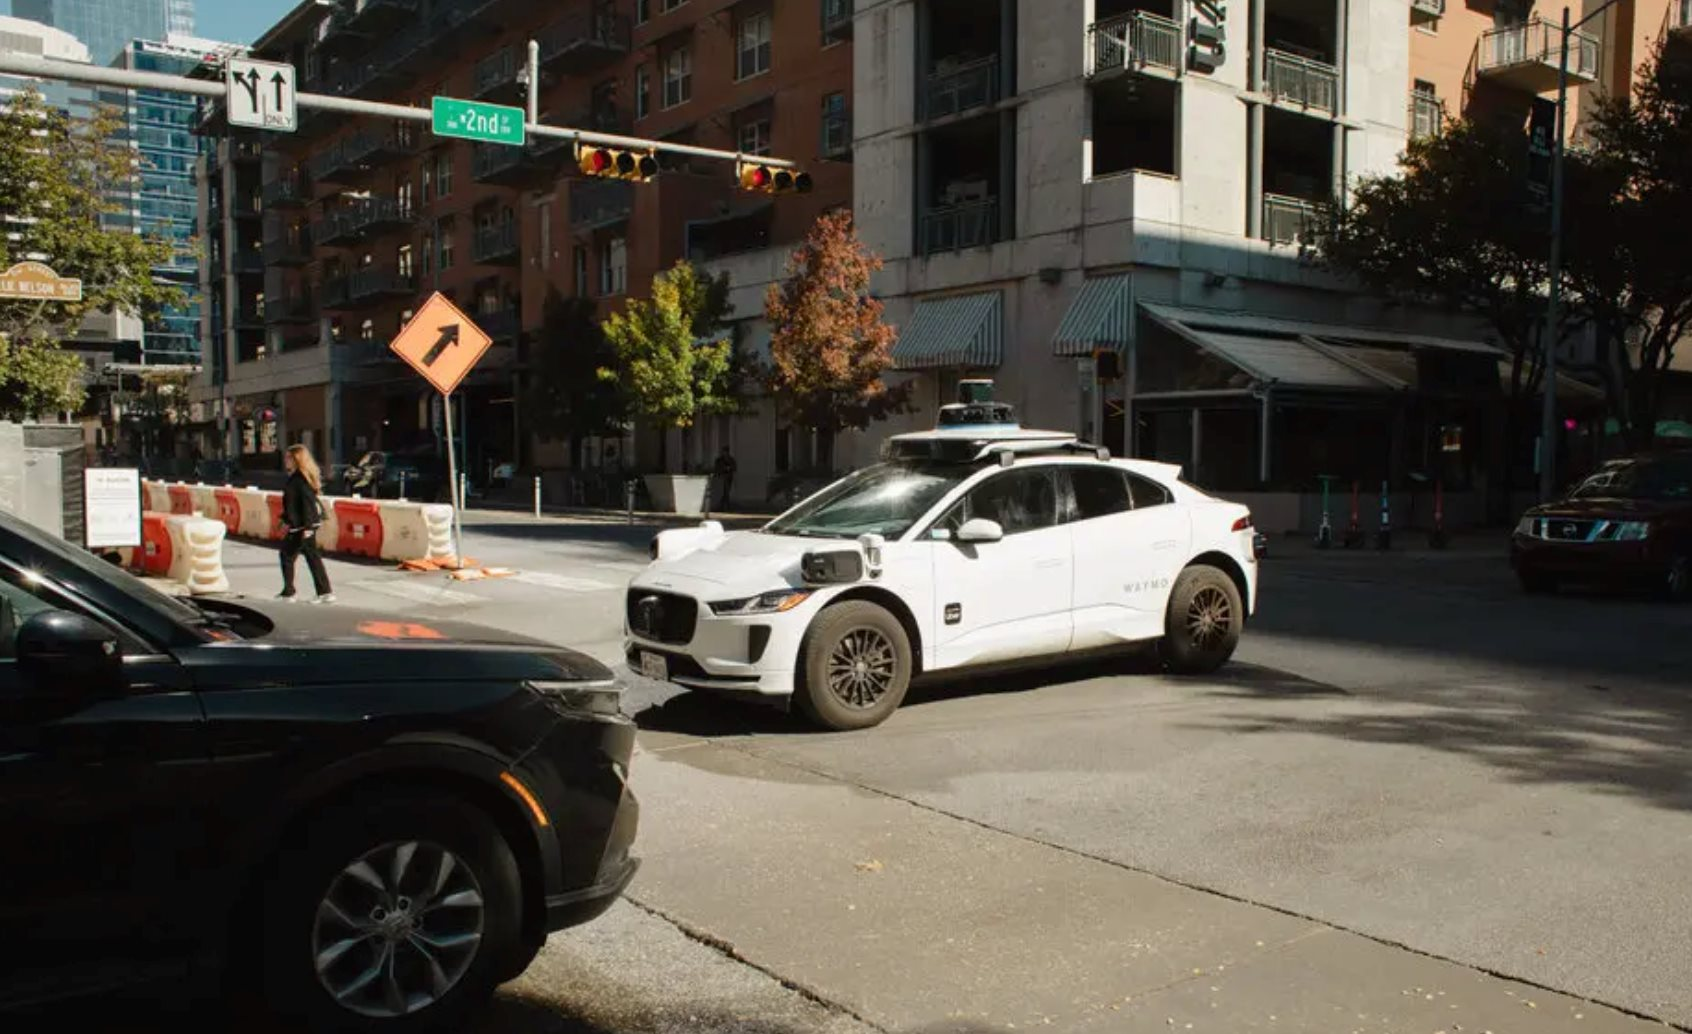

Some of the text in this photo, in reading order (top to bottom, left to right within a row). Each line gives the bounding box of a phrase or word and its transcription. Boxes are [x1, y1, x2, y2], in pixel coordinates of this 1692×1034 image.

[266, 115, 292, 127] ONLY
[466, 108, 499, 135] 2nd
[1123, 578, 1169, 593] WAYMO
